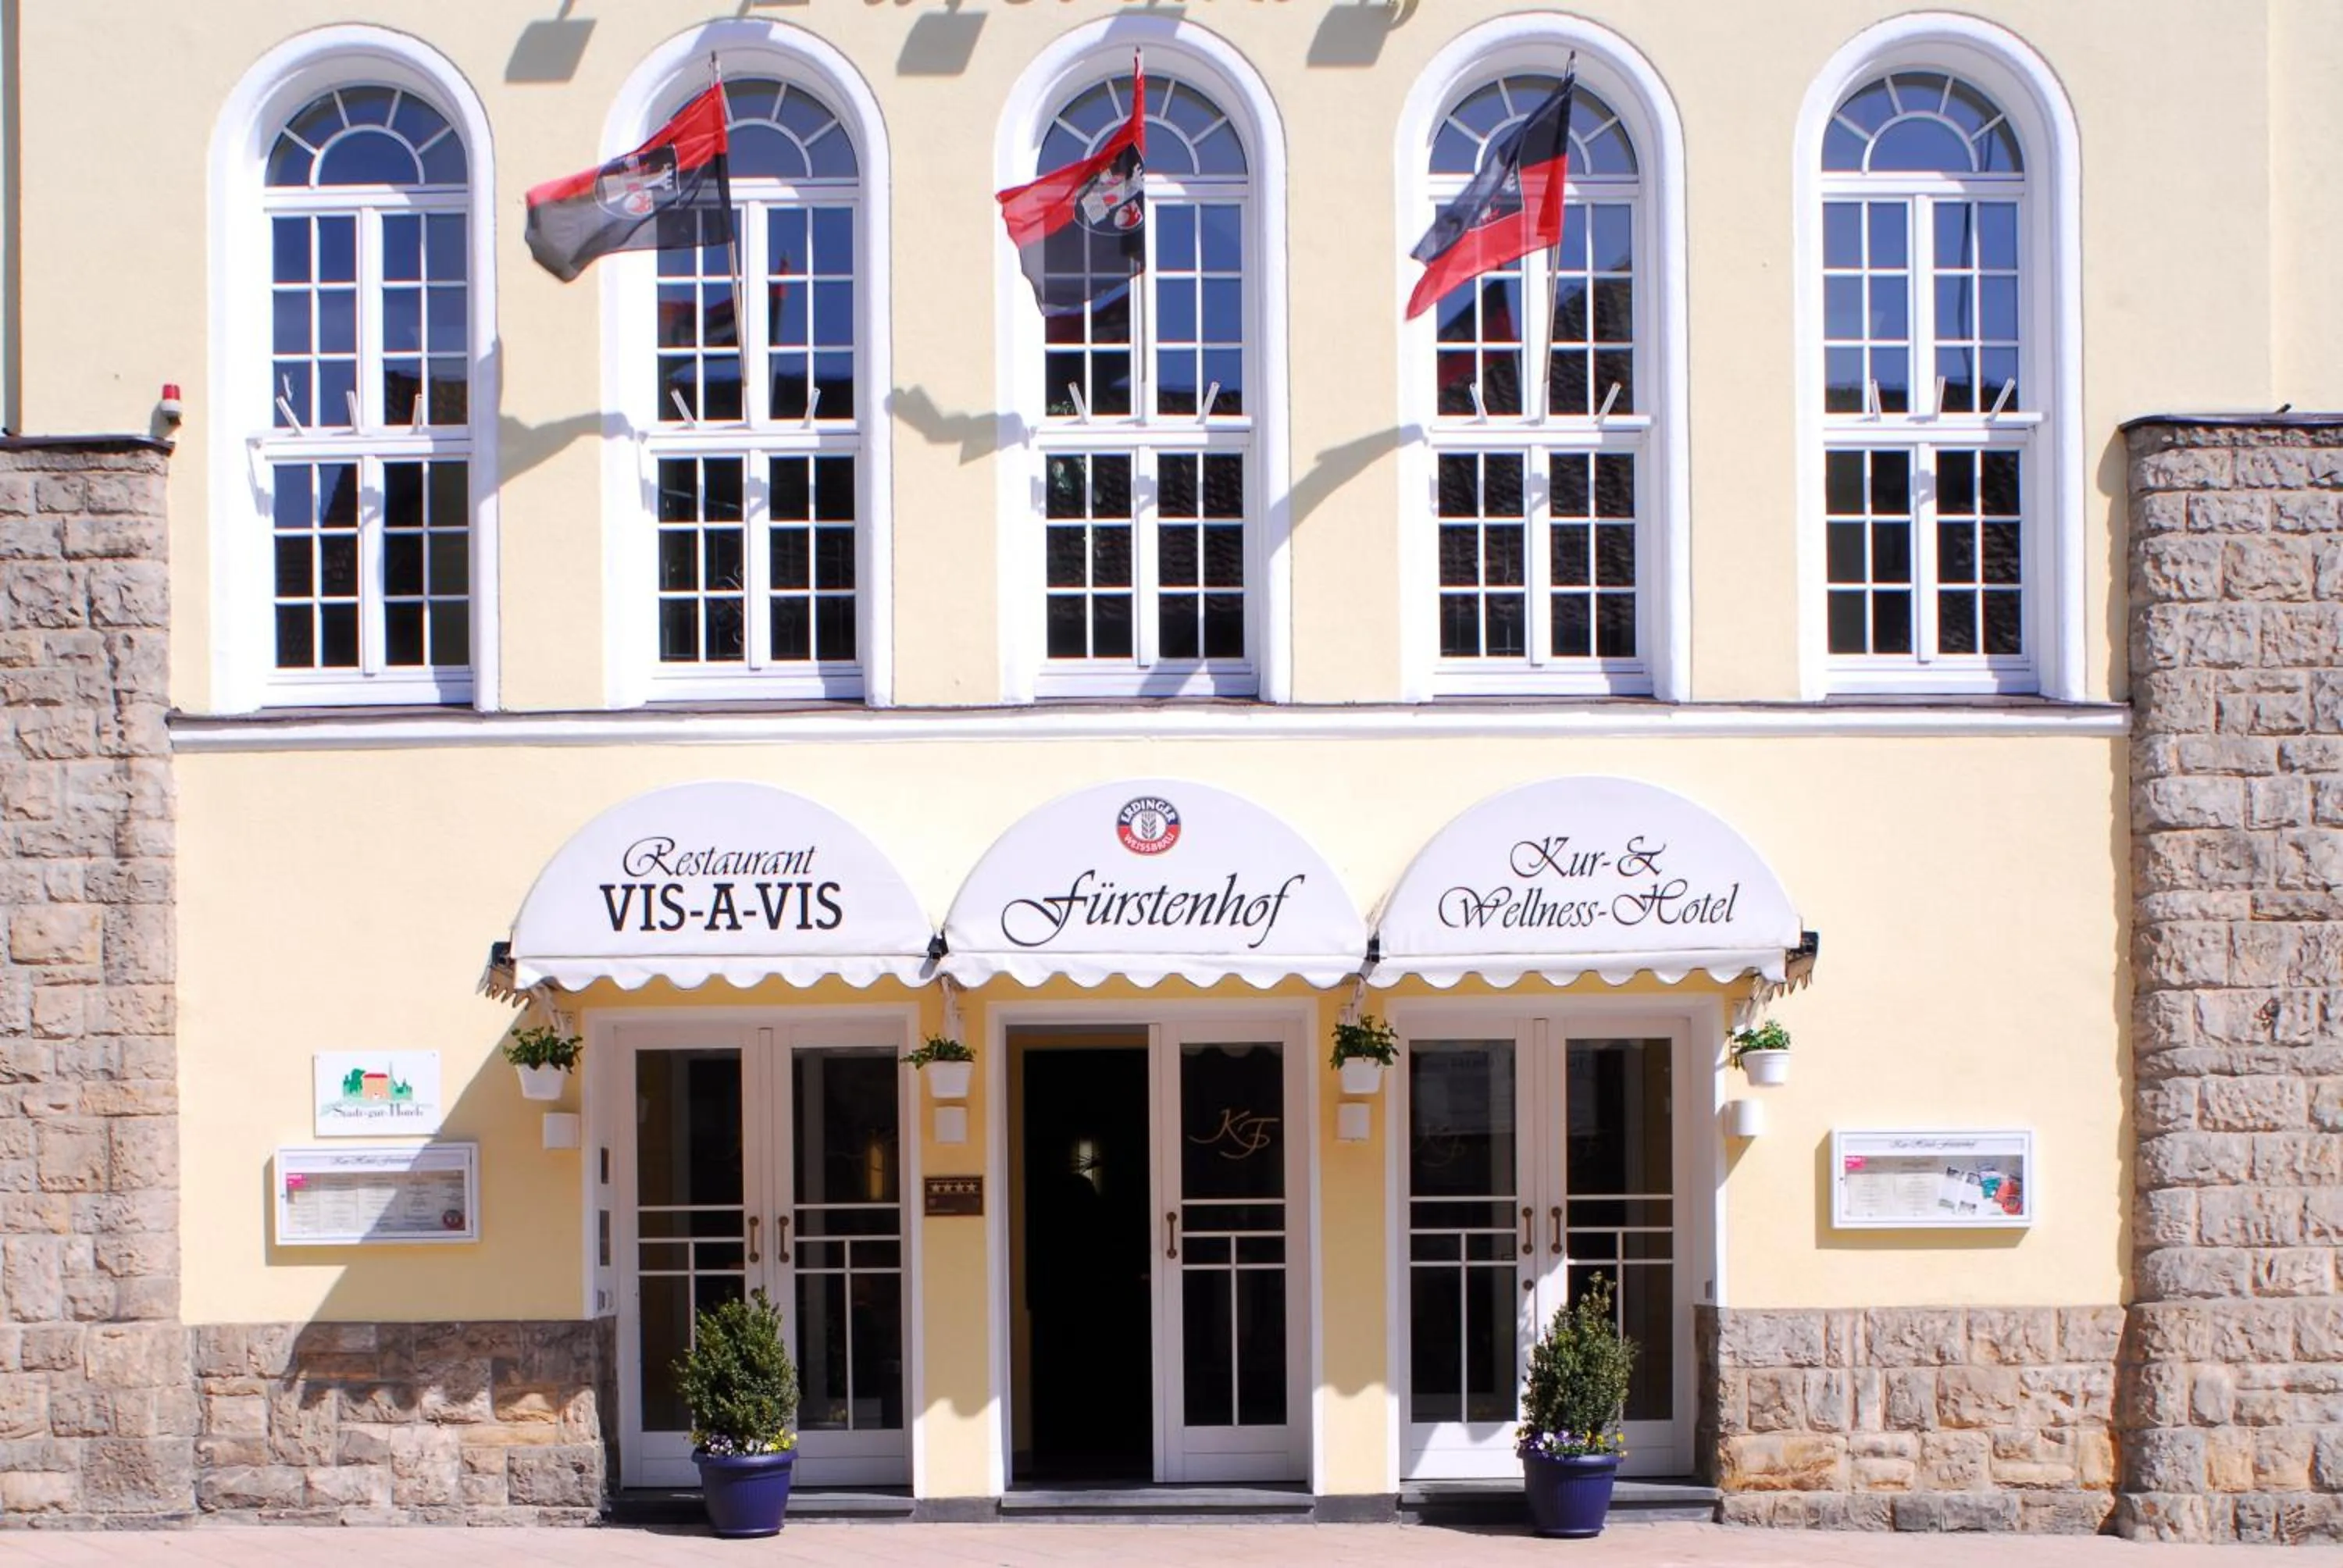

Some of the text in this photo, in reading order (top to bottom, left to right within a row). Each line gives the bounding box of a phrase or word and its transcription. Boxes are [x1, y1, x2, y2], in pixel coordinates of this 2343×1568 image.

[1121, 799, 1175, 823] ERDINGER
[622, 836, 815, 877] Restaurant
[1510, 836, 1610, 878] Kur-
[599, 882, 843, 932] VIS-A-VIS
[1001, 869, 1305, 948] Fürstenhof
[1439, 879, 1739, 928] Wellness-Hotel
